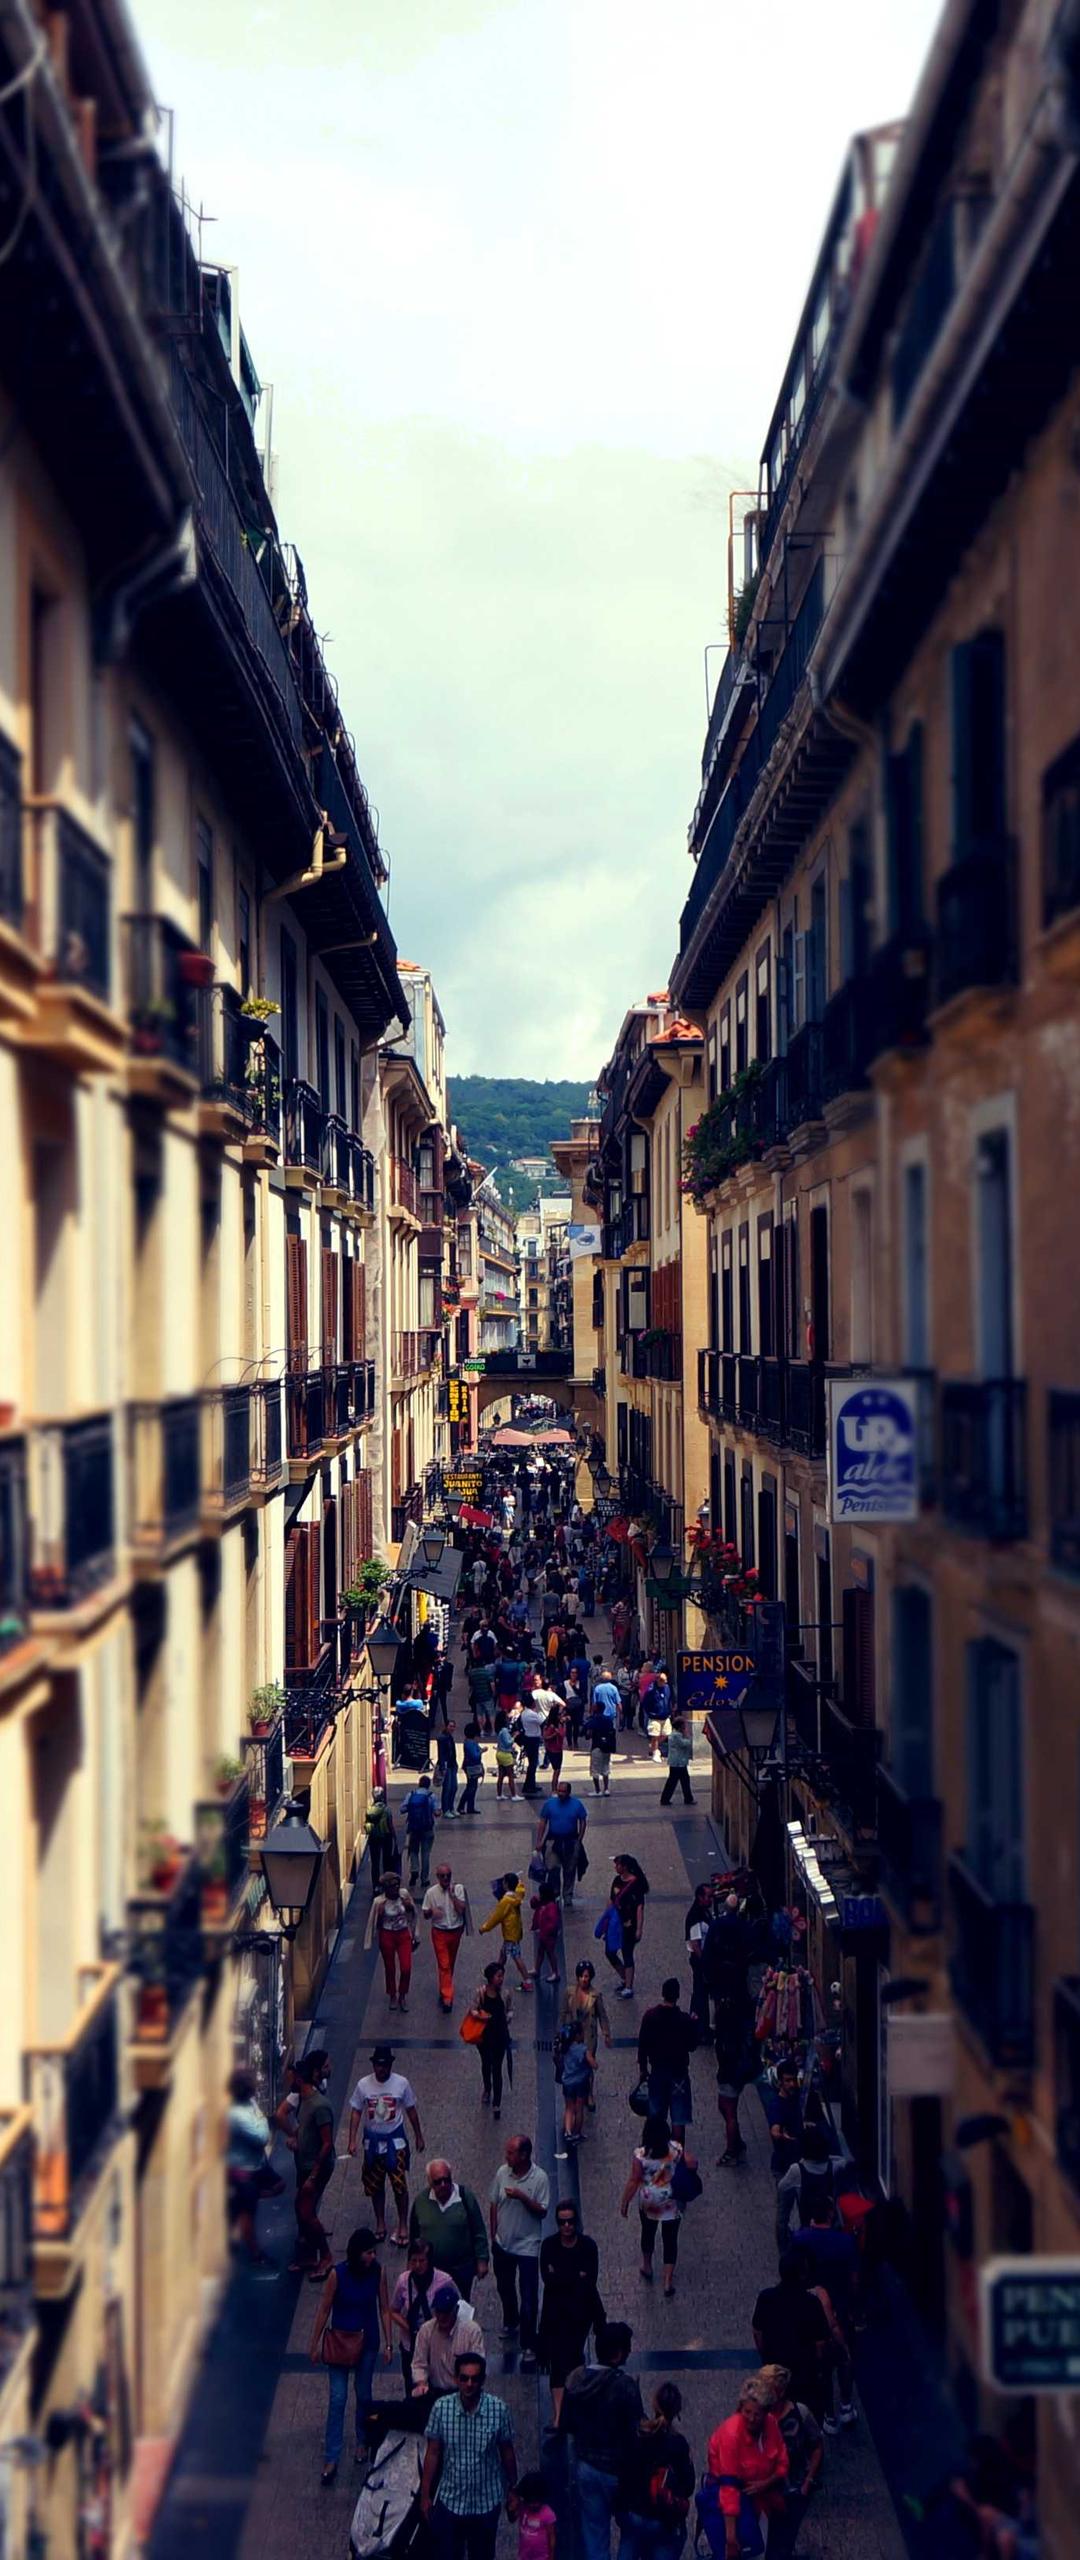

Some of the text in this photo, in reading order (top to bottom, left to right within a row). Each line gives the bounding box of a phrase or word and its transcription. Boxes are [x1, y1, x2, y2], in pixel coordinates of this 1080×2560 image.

[443, 1480, 483, 1488] JUANITO
[840, 1497, 909, 1515] Pents
[682, 1655, 755, 1673] PENSION
